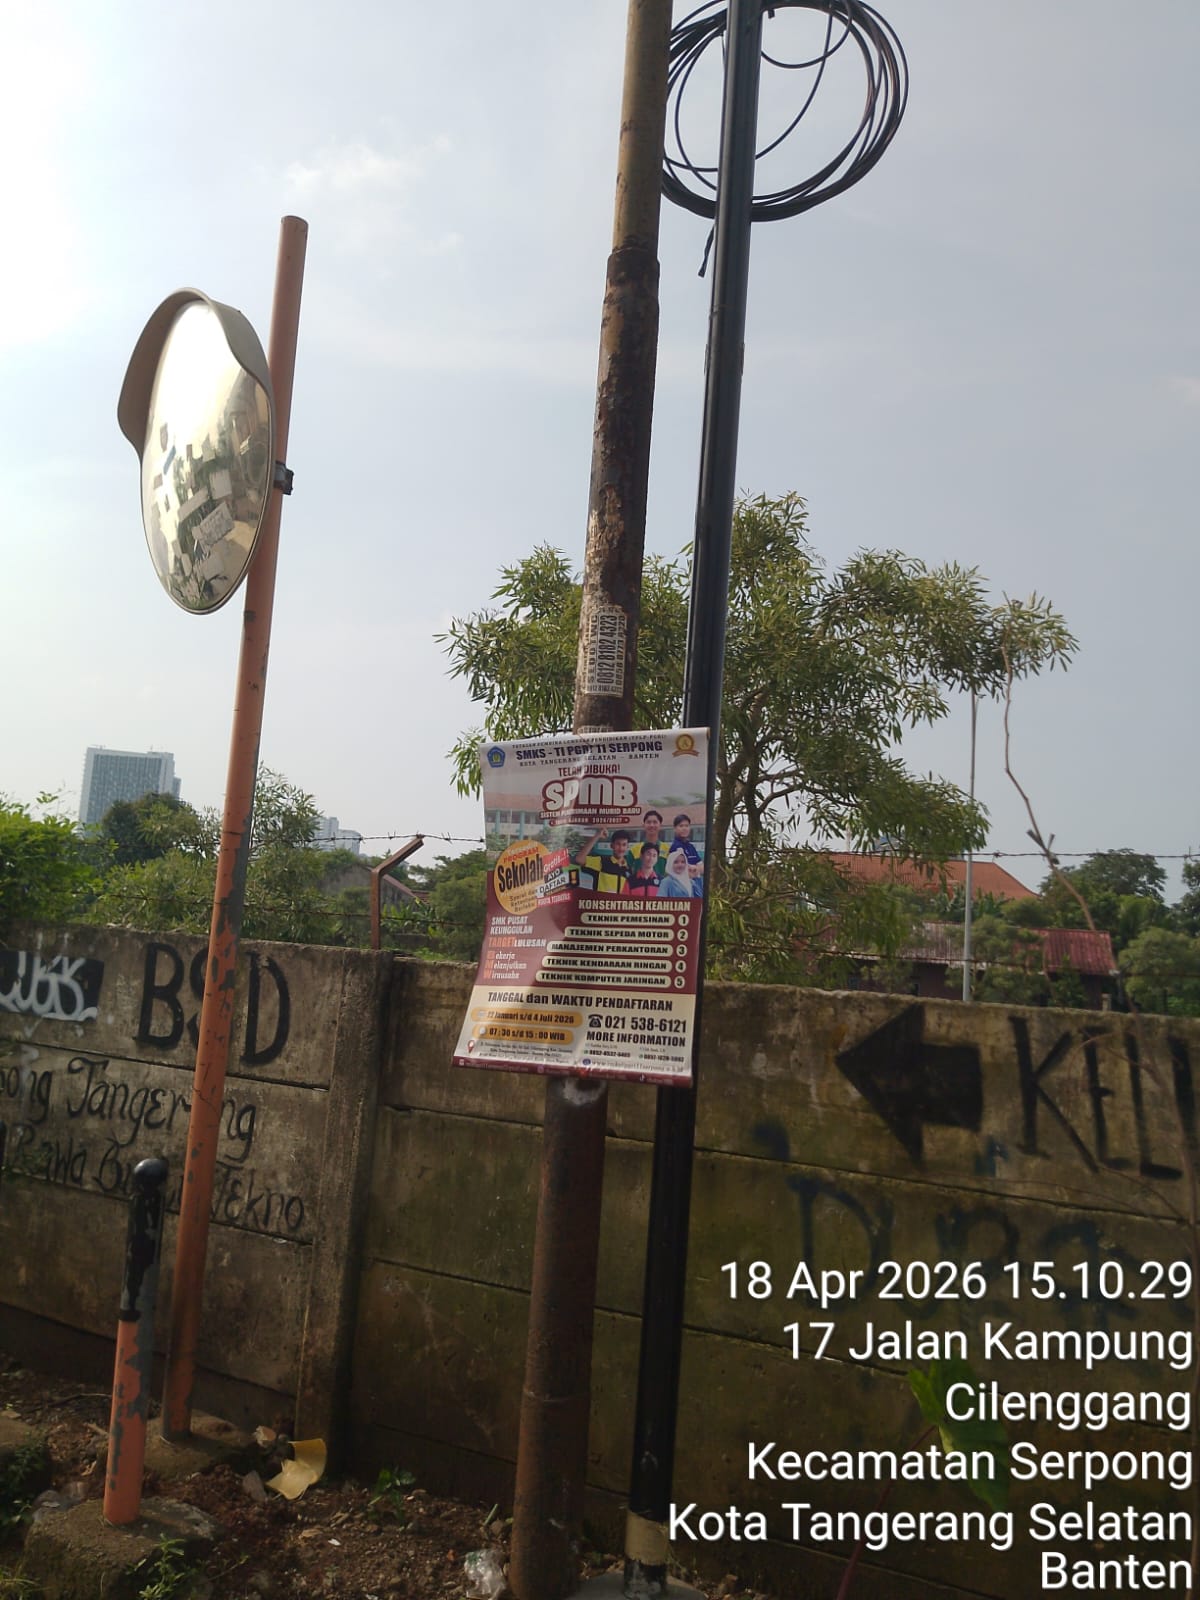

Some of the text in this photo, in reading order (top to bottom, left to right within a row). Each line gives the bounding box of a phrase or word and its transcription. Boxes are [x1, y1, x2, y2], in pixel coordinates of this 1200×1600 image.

[590, 614, 598, 638] WC
[599, 614, 618, 637] 4323
[598, 639, 617, 660] 8182
[597, 662, 615, 684] 0812
[516, 748, 546, 760] SMKS
[554, 747, 566, 756] TI
[609, 741, 663, 753] SERPONG
[584, 764, 620, 775] DIBUKA!
[542, 774, 638, 812] SPMB
[497, 854, 544, 892] Sekolah
[547, 868, 561, 881] AYO
[539, 876, 566, 894] DAFTAR
[578, 899, 691, 912] KONSENTRASI KEAHLIAN
[587, 914, 618, 922] TEKNIK
[620, 915, 670, 923] PEMESINAN
[570, 928, 603, 937] TEKNIK
[604, 929, 636, 938] SEPEDA
[638, 930, 669, 938] MOTOR
[552, 943, 604, 952] MANAJEMEN
[606, 945, 668, 954] PERKANTORAN
[547, 958, 578, 967] TEKNIK
[580, 960, 632, 969] KENDARAAN
[634, 961, 667, 970] RINGAN
[541, 973, 573, 981] TEKNIK
[575, 974, 622, 983] KOMPUTER
[624, 976, 666, 985] JARINGAN
[488, 992, 673, 1012] TANGGAL dan WAKTU PENDAFTARAN
[540, 1014, 553, 1022] Juli
[604, 1015, 687, 1033] 021 538-6121
[549, 1032, 565, 1040] WIB
[586, 1031, 614, 1042] MORE
[617, 1032, 686, 1047] INFORMATION
[67, 1057, 256, 1162] Tangerng
